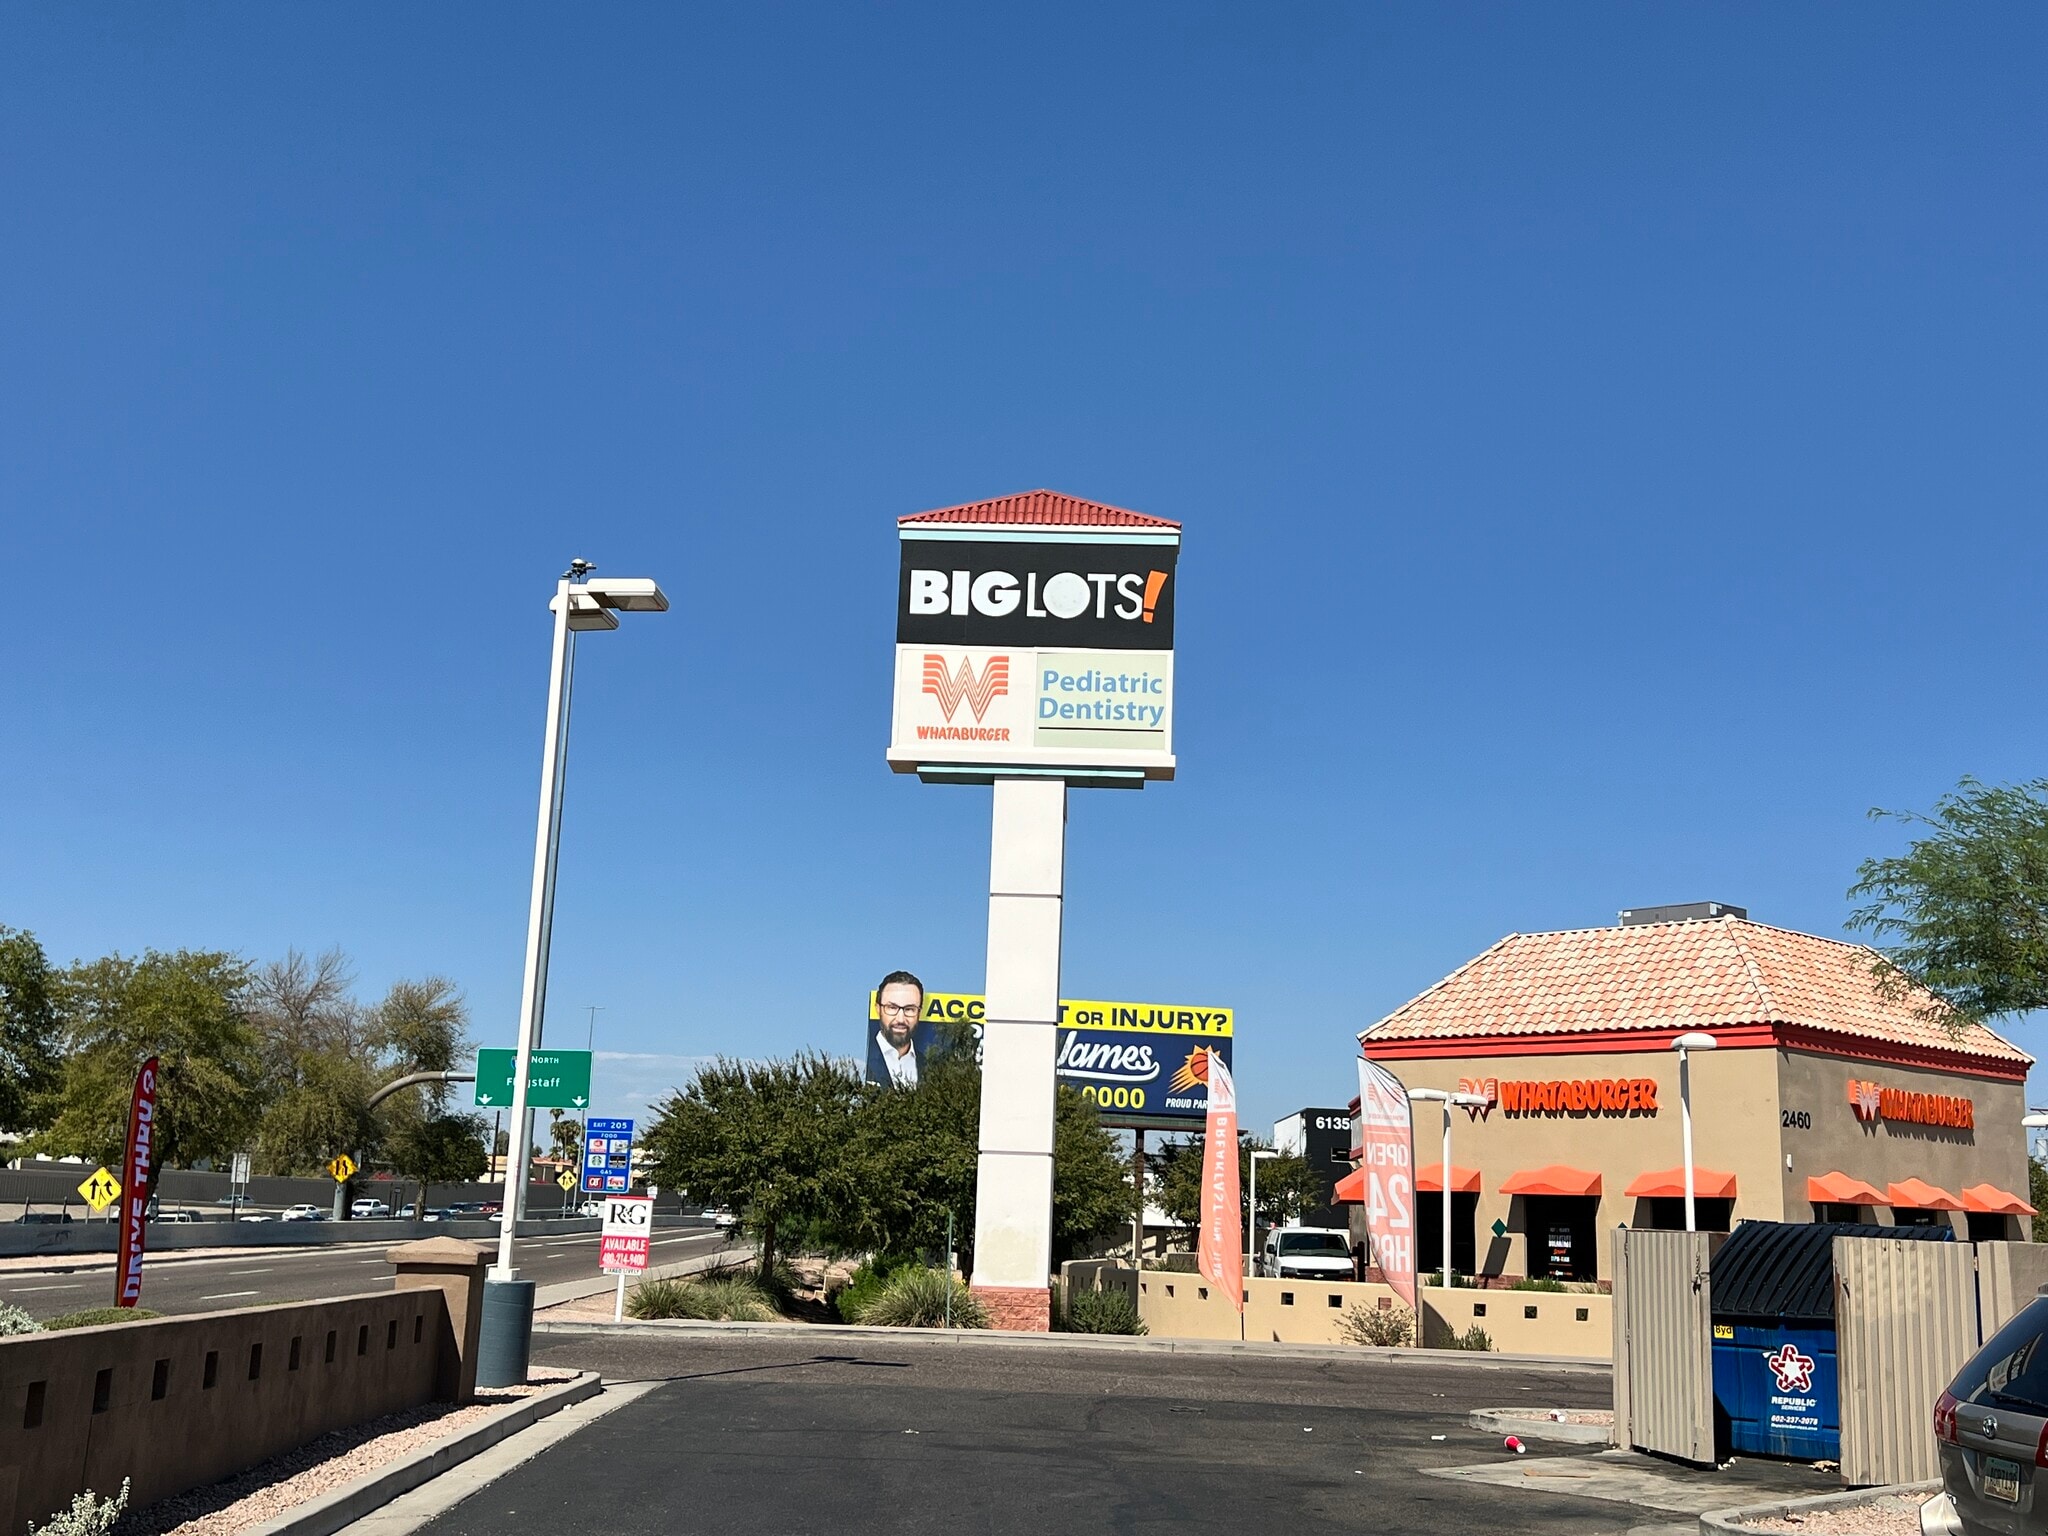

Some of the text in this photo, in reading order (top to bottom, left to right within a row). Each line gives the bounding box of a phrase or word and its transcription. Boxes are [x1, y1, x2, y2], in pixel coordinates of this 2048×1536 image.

[909, 570, 1168, 623] BIG LOTS!
[1043, 670, 1163, 694] Pediatric
[1039, 697, 1164, 727] Dentistry
[917, 725, 1010, 741] WHATABURGER
[1076, 1011, 1103, 1025] OR
[1112, 1008, 1228, 1031] INJURY?
[531, 1055, 560, 1064] NORTH
[1056, 1030, 1156, 1073] James
[1165, 1097, 1192, 1109] PROUD
[1500, 1078, 1658, 1112] WHATABURGER
[1881, 1087, 1976, 1130] WHATABURGER
[610, 1122, 627, 1130] 205
[1782, 1110, 1811, 1130] 2460
[608, 1203, 647, 1225] R&G
[604, 1237, 647, 1251] AVAILABLE
[1771, 1396, 1817, 1407] REPUBLIC
